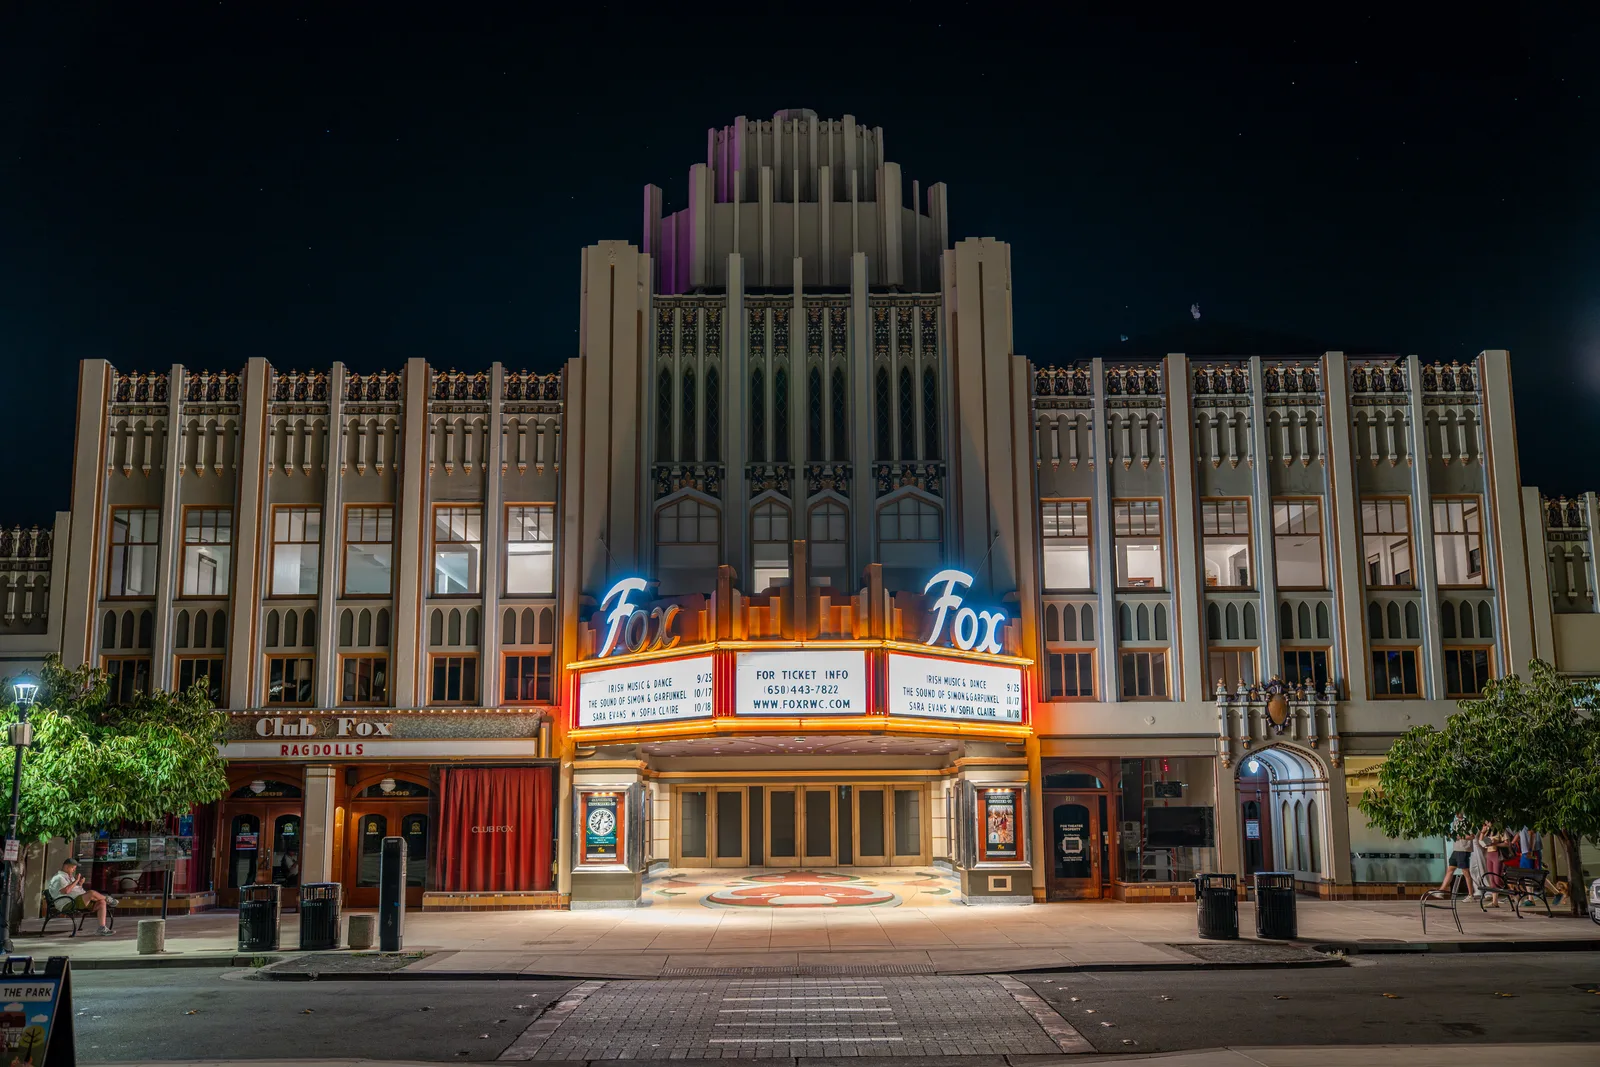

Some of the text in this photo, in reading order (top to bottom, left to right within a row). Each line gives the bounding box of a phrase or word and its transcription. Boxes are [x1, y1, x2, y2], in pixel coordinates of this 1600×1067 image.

[599, 577, 683, 657] Fox
[923, 569, 1005, 654] Fox
[696, 673, 712, 684] 9/25
[756, 669, 849, 680] FOR TICKET INFO
[608, 677, 672, 693] IRISH MUSIC & DANCE
[926, 674, 987, 689] IRISH MUSIC & DANCE
[1006, 683, 1020, 693] 9/25
[694, 687, 712, 698] 10/17
[763, 684, 839, 695] (650)443-7822
[903, 686, 914, 696] THE
[915, 688, 936, 699] SOUND
[938, 689, 945, 699] OF
[588, 690, 687, 709] THE SOUND OF SIMON & GARFUNKEL
[753, 699, 851, 710] WWW.FOXRWC.COM
[592, 712, 606, 722] SARA
[608, 709, 627, 720] EVANS
[658, 704, 679, 716] CLAIRE
[694, 703, 711, 713] 10/18
[908, 701, 925, 712] SARA
[928, 703, 947, 714] EVANS
[977, 706, 996, 717] CLAIRE
[255, 717, 393, 737] Club Fox
[281, 743, 364, 756] RAGDOLLS
[471, 825, 514, 833] CLUB FOX
[4, 987, 52, 997] THE PARK
